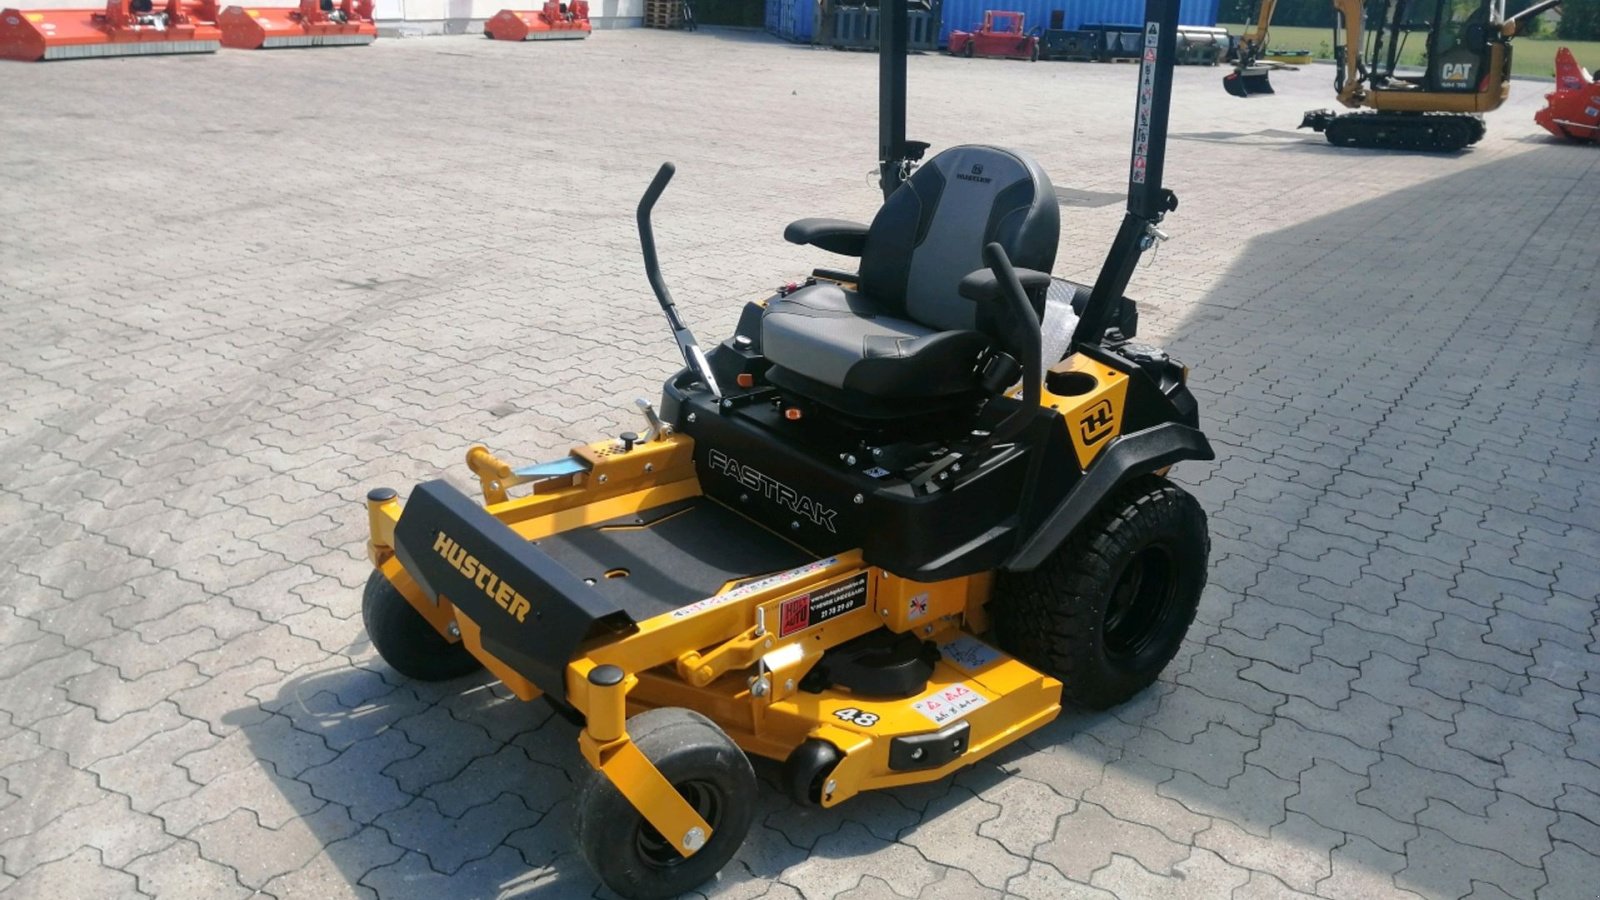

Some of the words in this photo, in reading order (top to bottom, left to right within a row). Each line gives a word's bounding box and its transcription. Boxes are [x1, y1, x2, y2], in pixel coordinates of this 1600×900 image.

[1442, 63, 1472, 80] CAT
[709, 449, 838, 534] FASTRAK
[432, 530, 532, 623] HUSTLER
[837, 603, 845, 613] 29
[832, 707, 880, 728] 48
